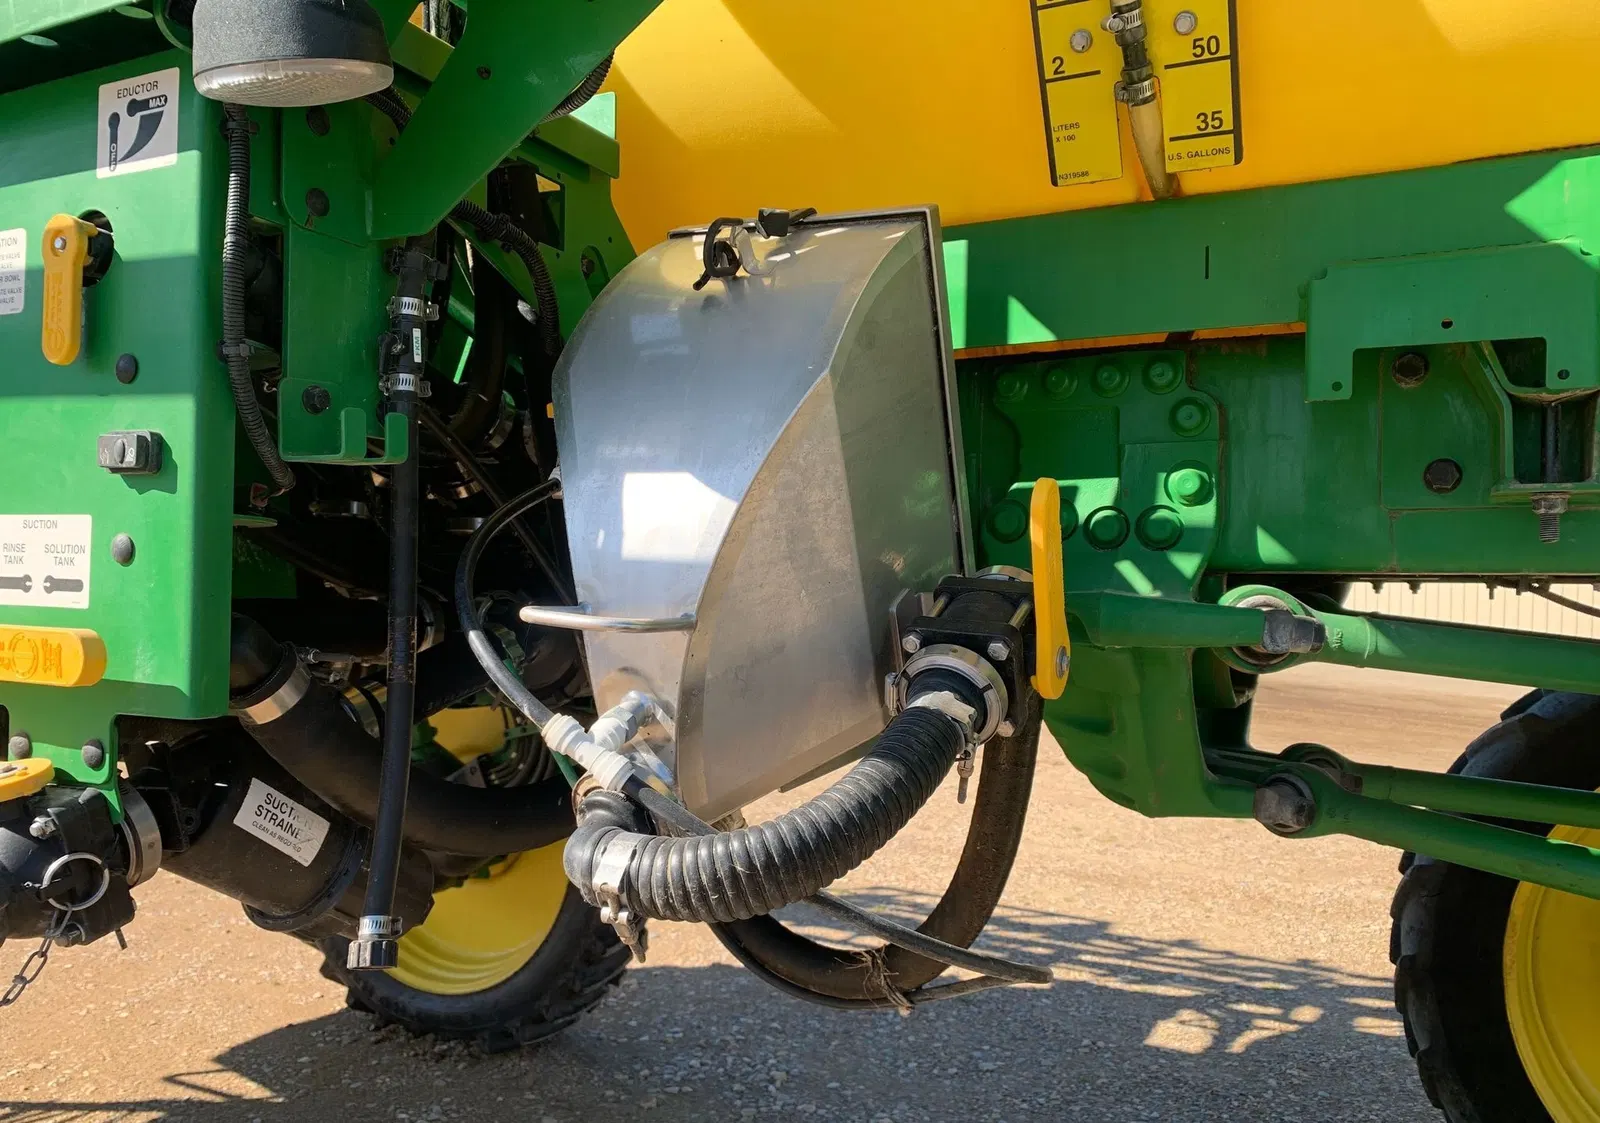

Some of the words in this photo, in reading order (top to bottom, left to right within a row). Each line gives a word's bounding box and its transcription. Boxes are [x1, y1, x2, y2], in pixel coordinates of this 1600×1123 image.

[1192, 35, 1221, 59] 50
[1051, 56, 1066, 76] 2
[117, 81, 158, 98] EDUCTOR
[149, 96, 166, 108] MAX
[1052, 121, 1081, 133] LITERS
[1195, 110, 1224, 132] 35
[1063, 134, 1076, 142] 100
[1167, 151, 1186, 161] U.S.
[1186, 146, 1231, 159] GALLONS
[22, 519, 58, 529] SUCTION
[2, 543, 26, 553] RINSE
[44, 543, 86, 555] SOLUTION
[4, 554, 24, 565] TANK
[53, 555, 75, 567] TANK
[252, 820, 270, 834] CLEAN
[269, 831, 278, 839] AS
